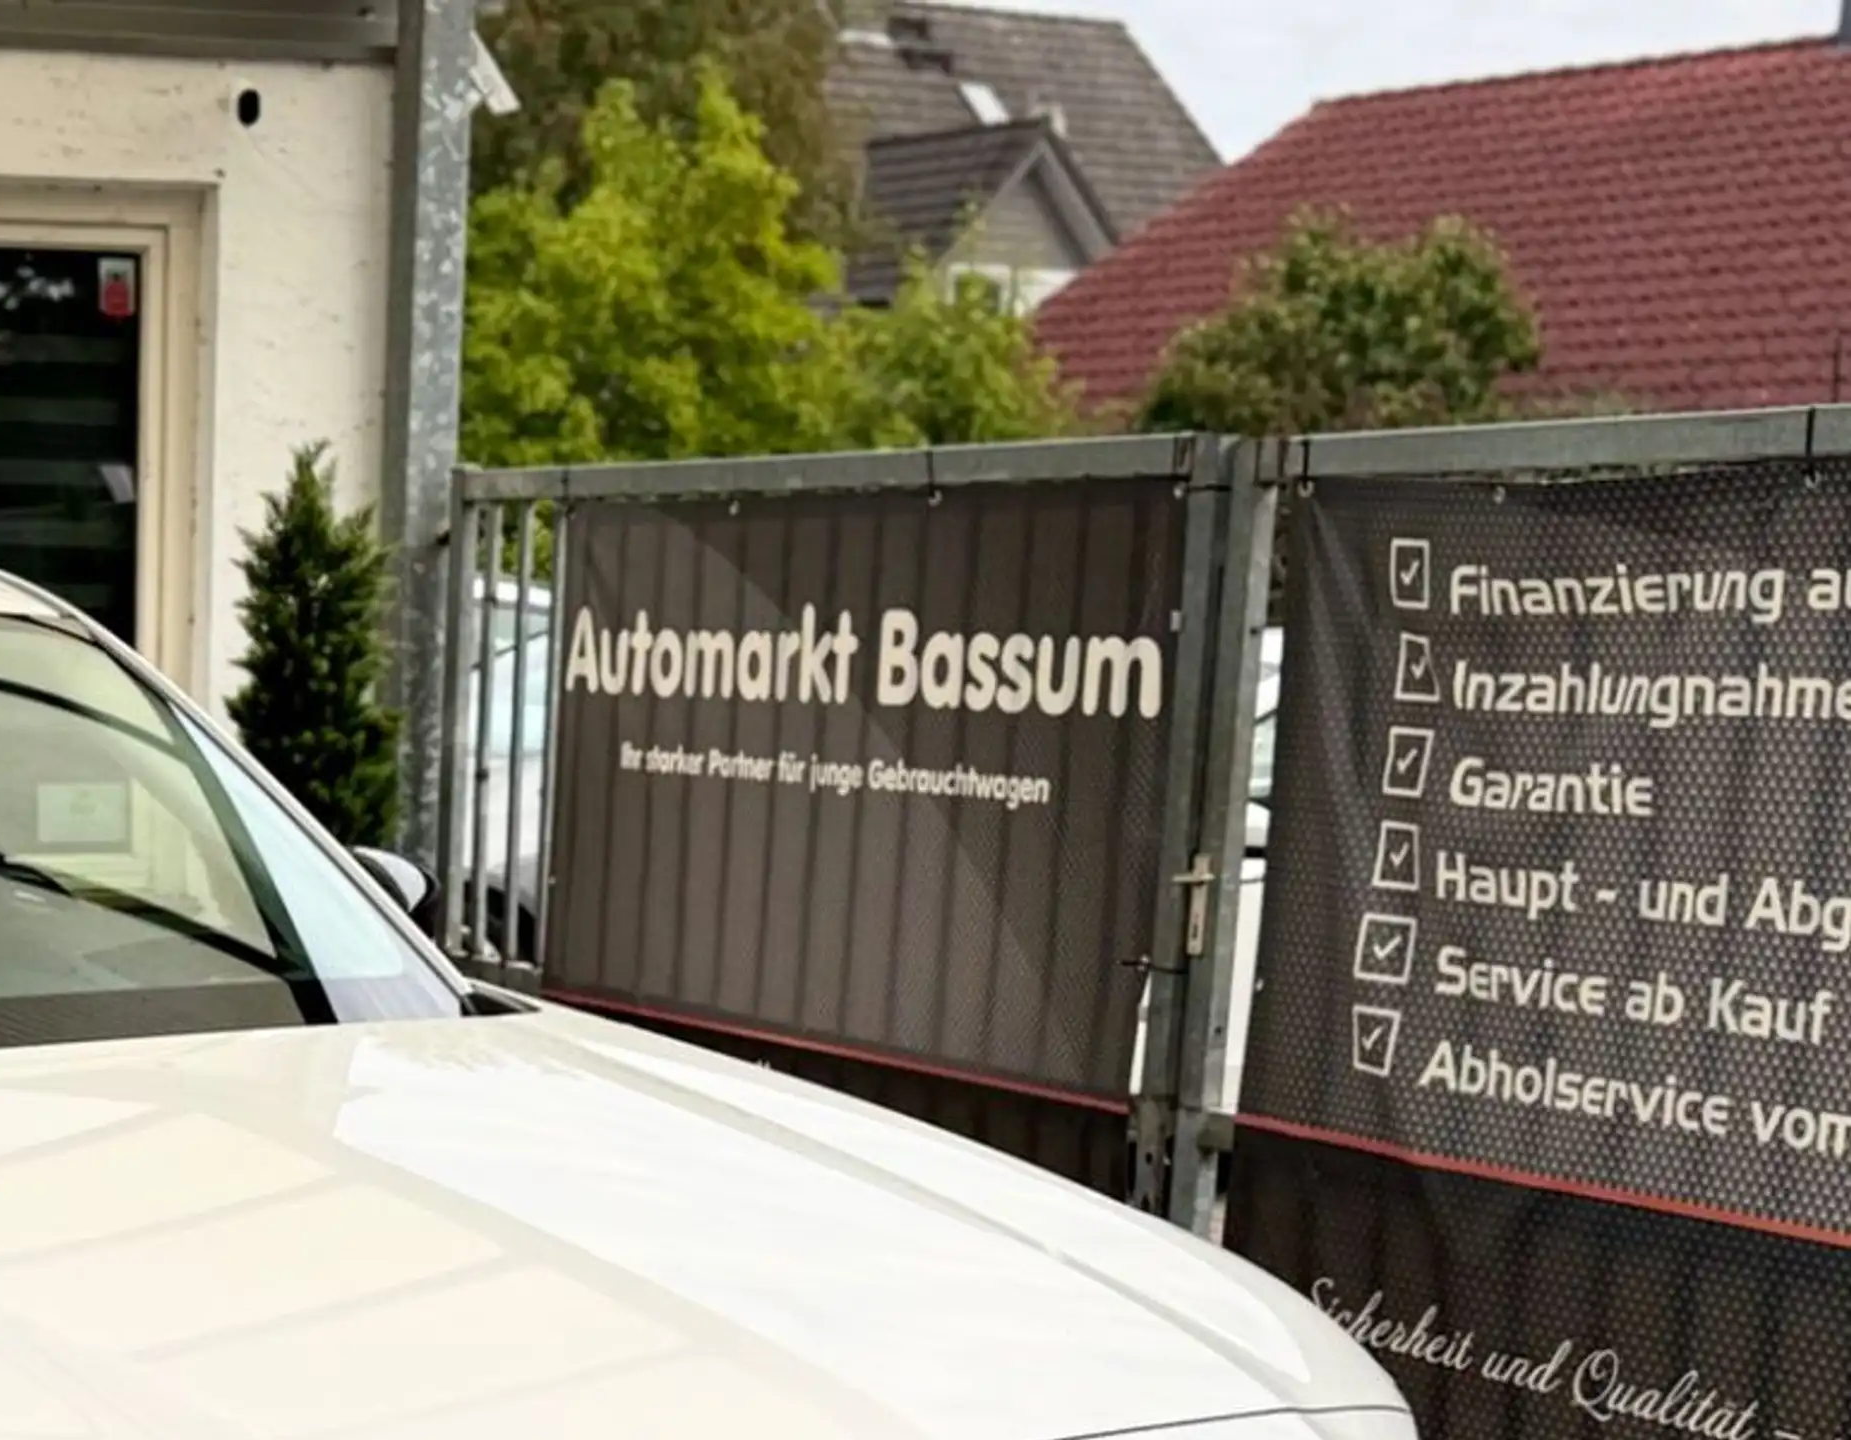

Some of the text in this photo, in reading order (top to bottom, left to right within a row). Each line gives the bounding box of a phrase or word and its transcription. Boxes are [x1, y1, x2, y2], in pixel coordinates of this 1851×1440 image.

[1450, 563, 1851, 624] Finanzierung a
[565, 602, 1162, 719] Automarkt Bassum
[620, 740, 1051, 810] Ihr starker Partner für junge Gebrauchtwagen
[1450, 757, 1654, 816] Garantie
[1435, 850, 1579, 919] Haupt
[1639, 873, 1729, 927] und
[1745, 876, 1851, 952] Abg
[1435, 945, 1836, 1045] Service ab Kauf
[1418, 1038, 1733, 1136] Abholservice
[1481, 1339, 1574, 1393] und
